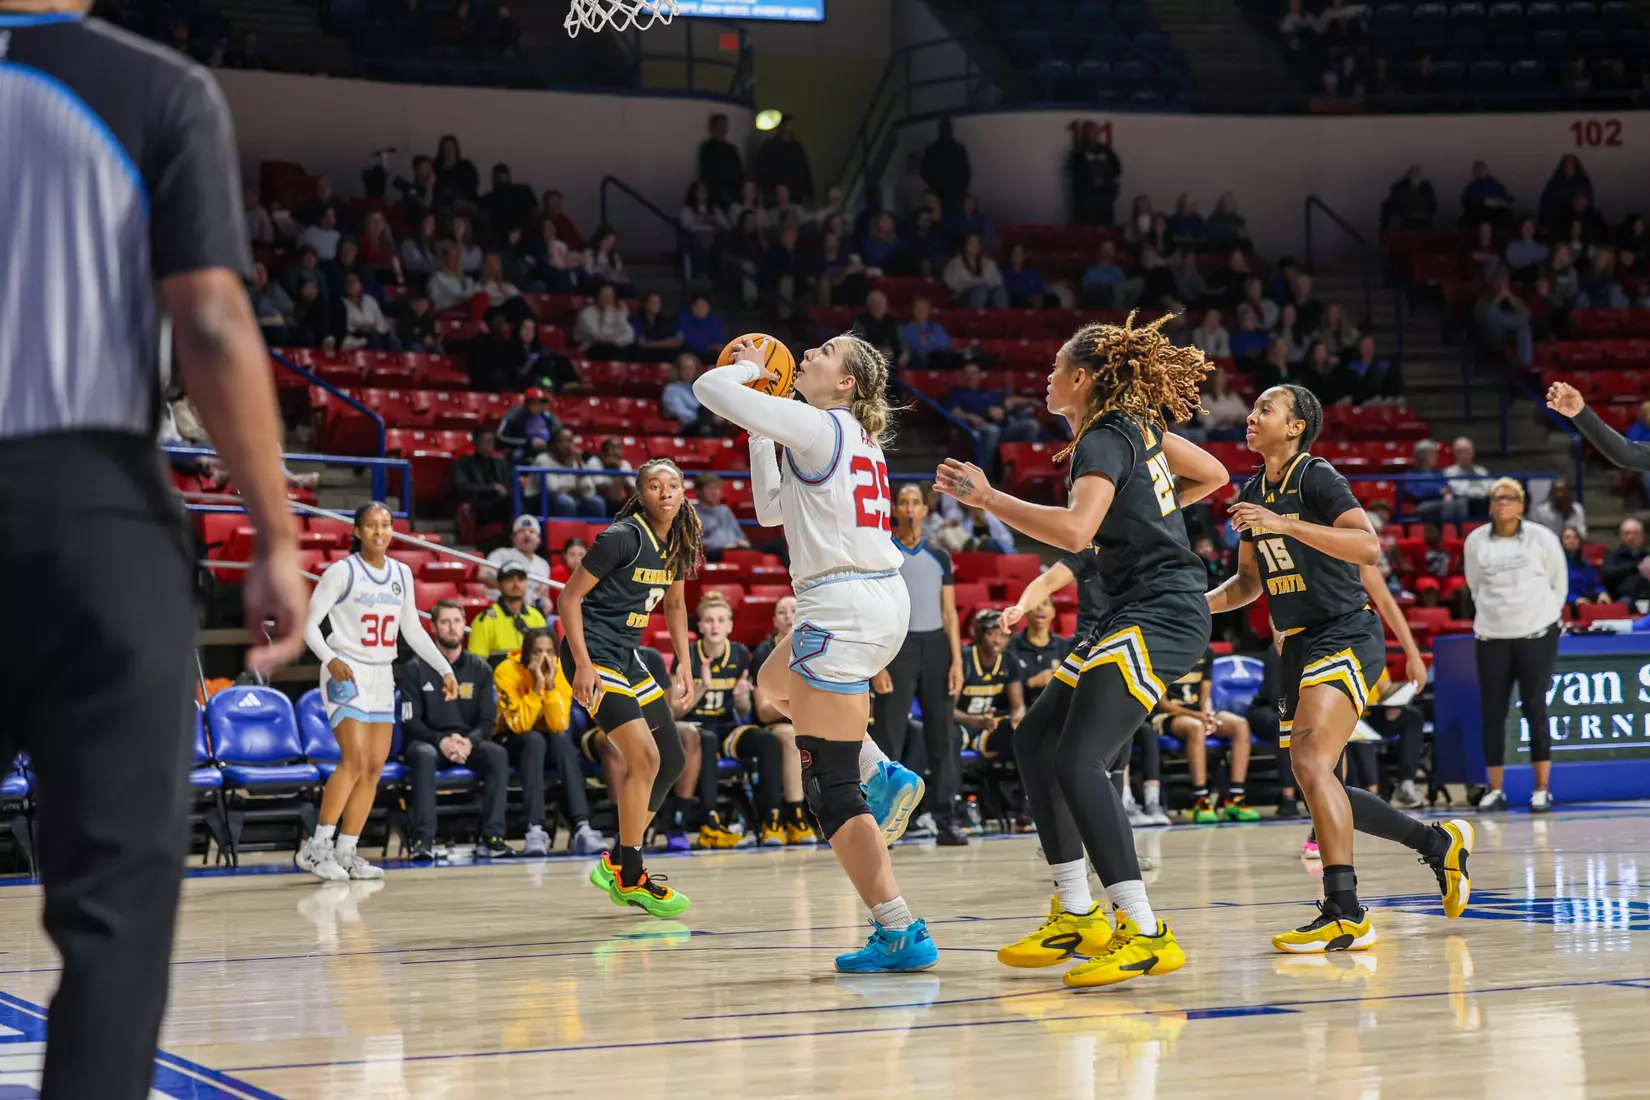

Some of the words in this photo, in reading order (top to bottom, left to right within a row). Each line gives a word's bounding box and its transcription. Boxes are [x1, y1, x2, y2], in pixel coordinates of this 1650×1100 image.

[1064, 119, 1112, 147] 11
[1568, 119, 1623, 147] 102
[850, 455, 892, 531] 25
[1257, 537, 1295, 574] 15
[1266, 573, 1307, 596] STATE
[360, 613, 396, 647] 30
[1544, 671, 1624, 706] van
